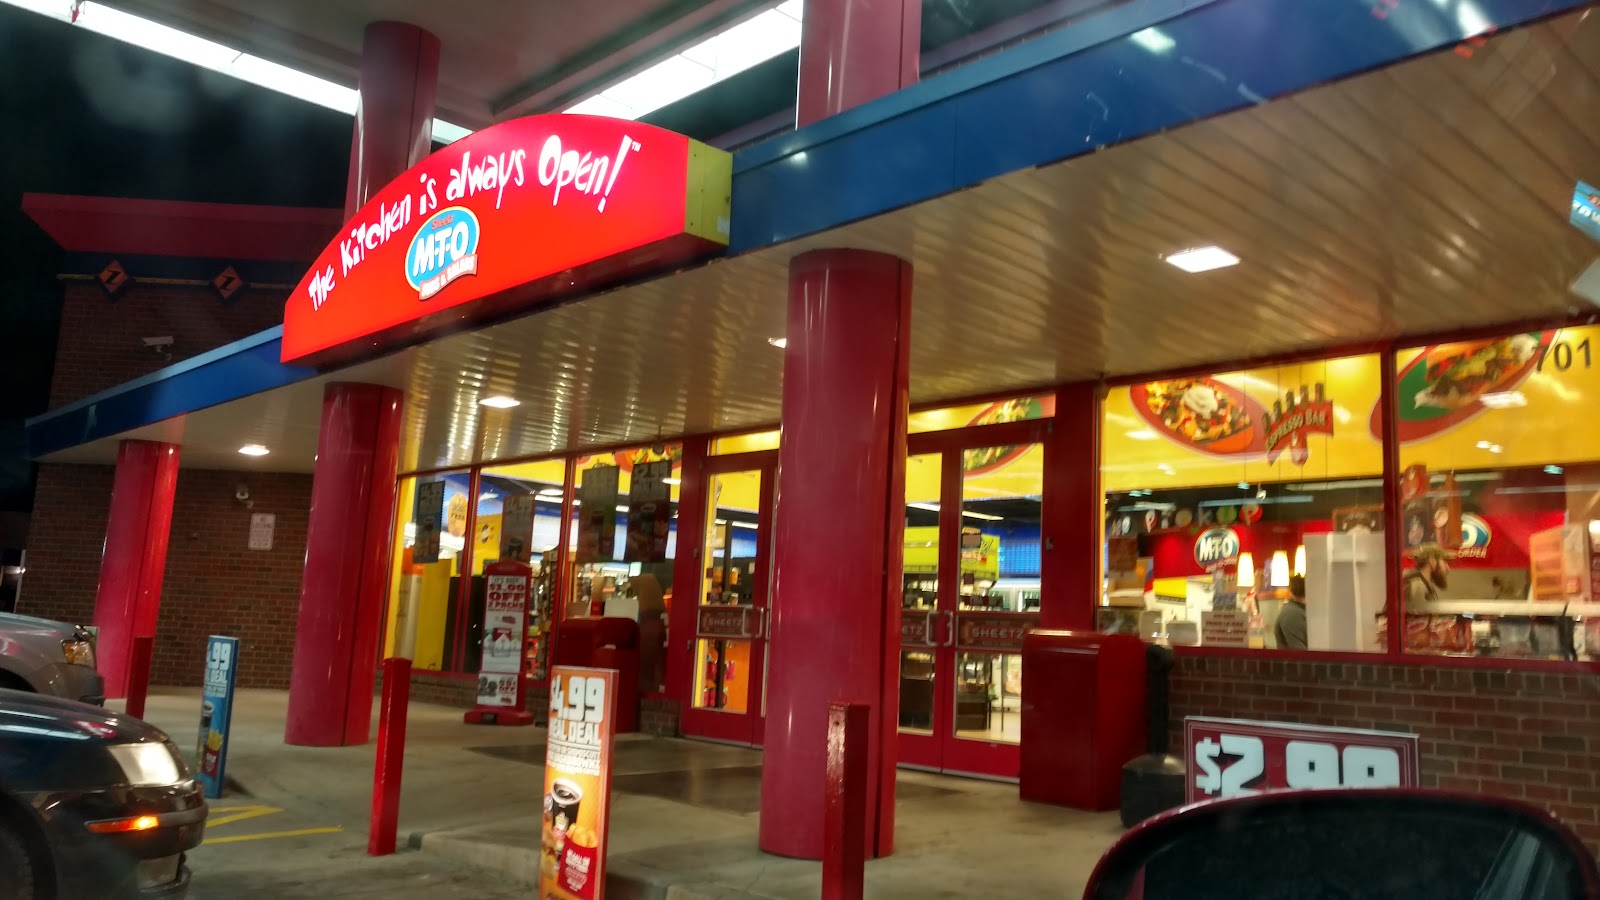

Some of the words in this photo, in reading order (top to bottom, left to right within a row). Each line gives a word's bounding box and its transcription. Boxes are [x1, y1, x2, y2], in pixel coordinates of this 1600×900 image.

[307, 264, 336, 311] The
[419, 173, 438, 216] is
[445, 148, 527, 210] always
[1532, 336, 1592, 374] 701
[489, 591, 525, 602] OFF
[972, 626, 1024, 640] SHEETZ
[567, 719, 602, 747] DEAL
[1195, 733, 1400, 800] $299
